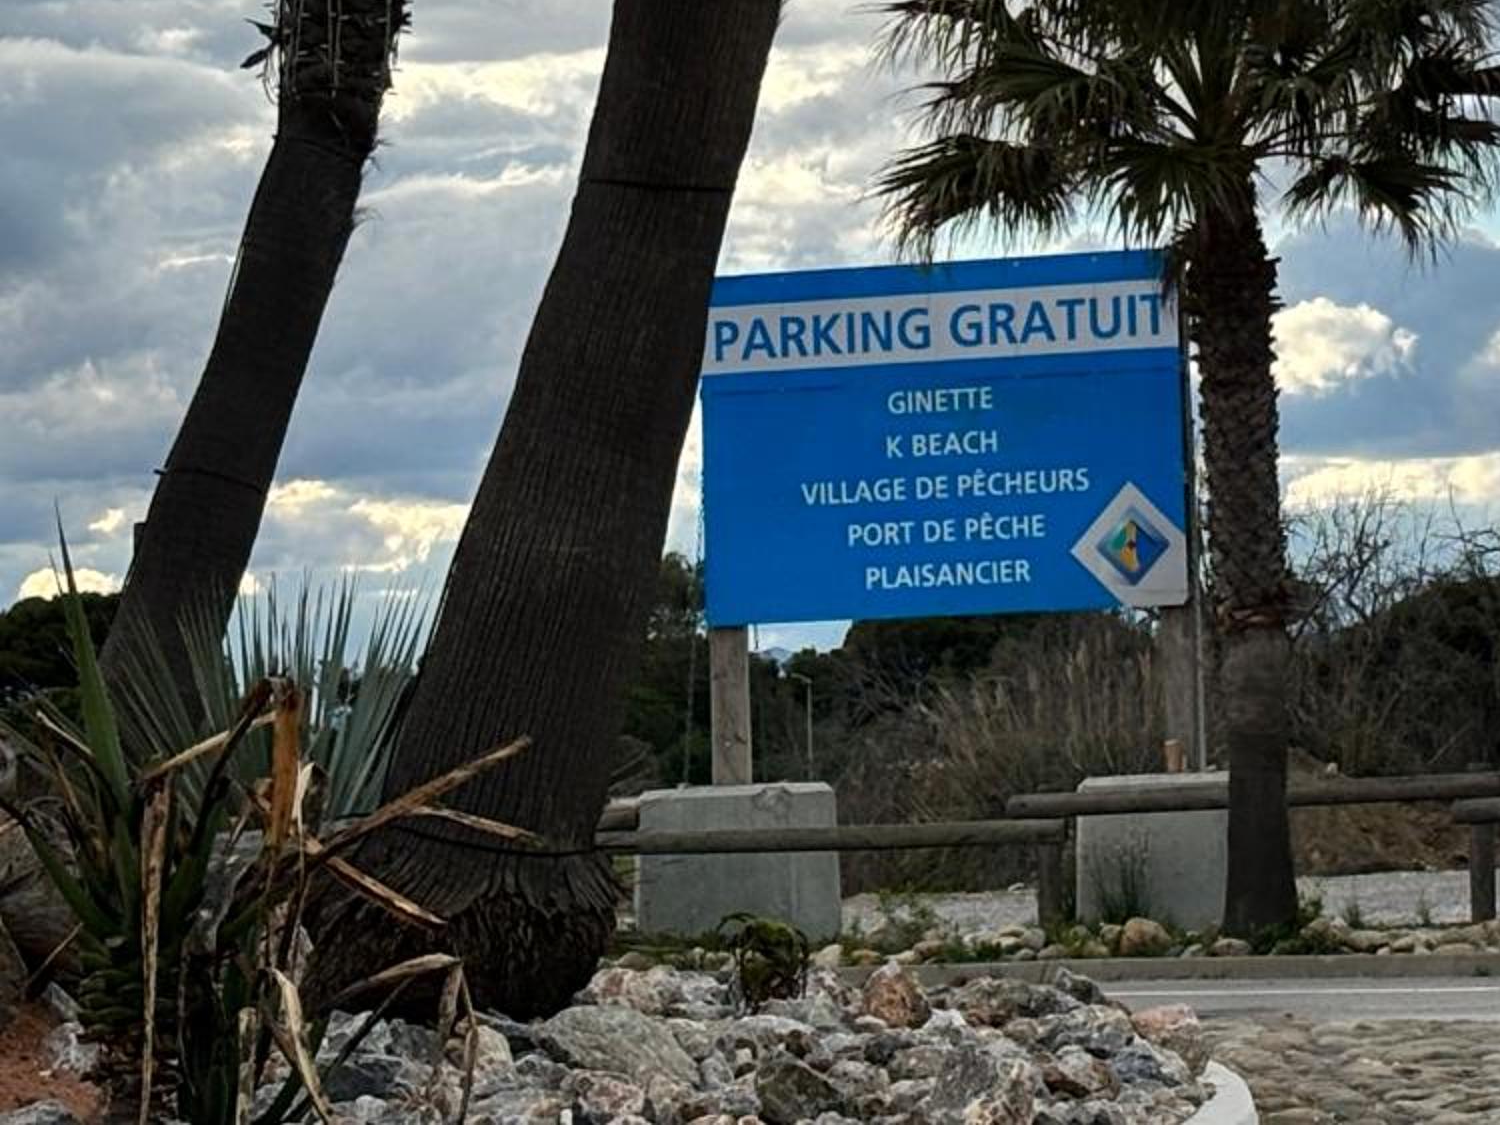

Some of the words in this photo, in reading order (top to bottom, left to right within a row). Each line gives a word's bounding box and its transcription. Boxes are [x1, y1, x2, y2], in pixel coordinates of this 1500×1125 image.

[714, 307, 932, 363] PARKING
[949, 293, 1162, 348] GRATUIT
[889, 387, 992, 413] GINETTE
[887, 437, 902, 457] K
[913, 431, 996, 456] BEACH
[802, 479, 905, 504] VILLAGE
[917, 477, 947, 499] DE
[958, 469, 1088, 496] PÊCHEURS
[849, 522, 913, 545] PORT
[924, 520, 954, 542] DE
[966, 513, 1044, 539] PÊCHE
[867, 560, 1030, 589] PLAISANCIER
